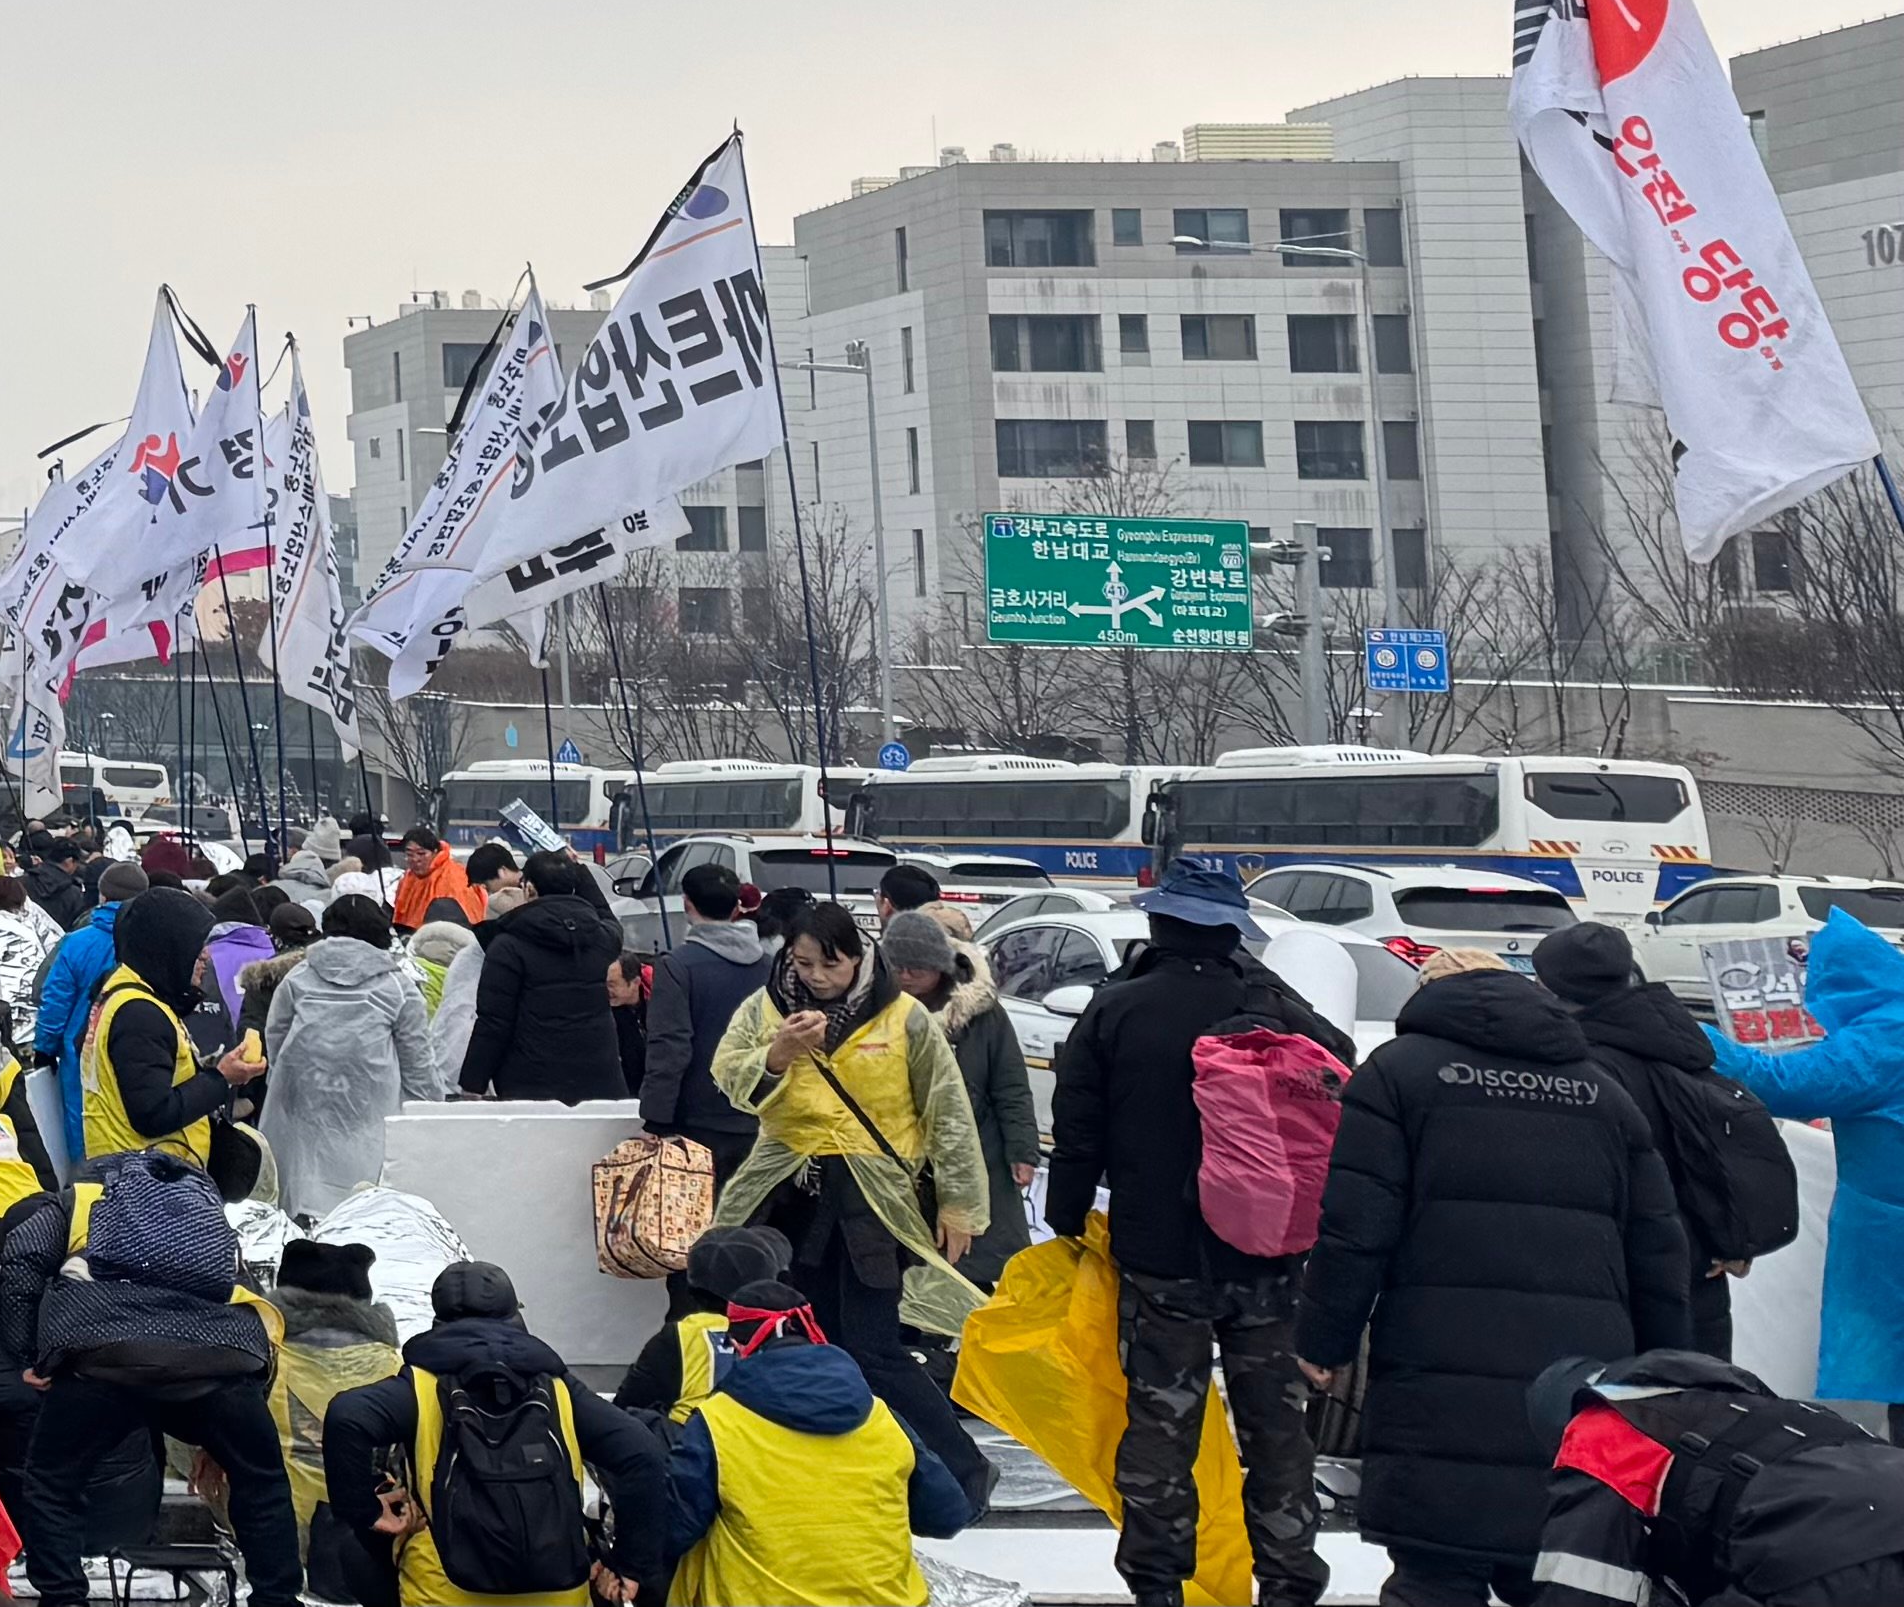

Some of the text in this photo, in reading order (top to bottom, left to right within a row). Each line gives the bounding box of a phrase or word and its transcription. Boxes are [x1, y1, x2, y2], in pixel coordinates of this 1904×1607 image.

[1015, 518, 1110, 539] 경부고속도로
[1117, 528, 1161, 543] Gyeongbu
[1031, 541, 1111, 561] 한남대교
[1170, 569, 1247, 589] 강변북로
[990, 588, 1068, 610] 금호사거리
[1097, 629, 1139, 644] 450m
[1065, 852, 1098, 868] POLICE
[1592, 870, 1645, 884] POLICE
